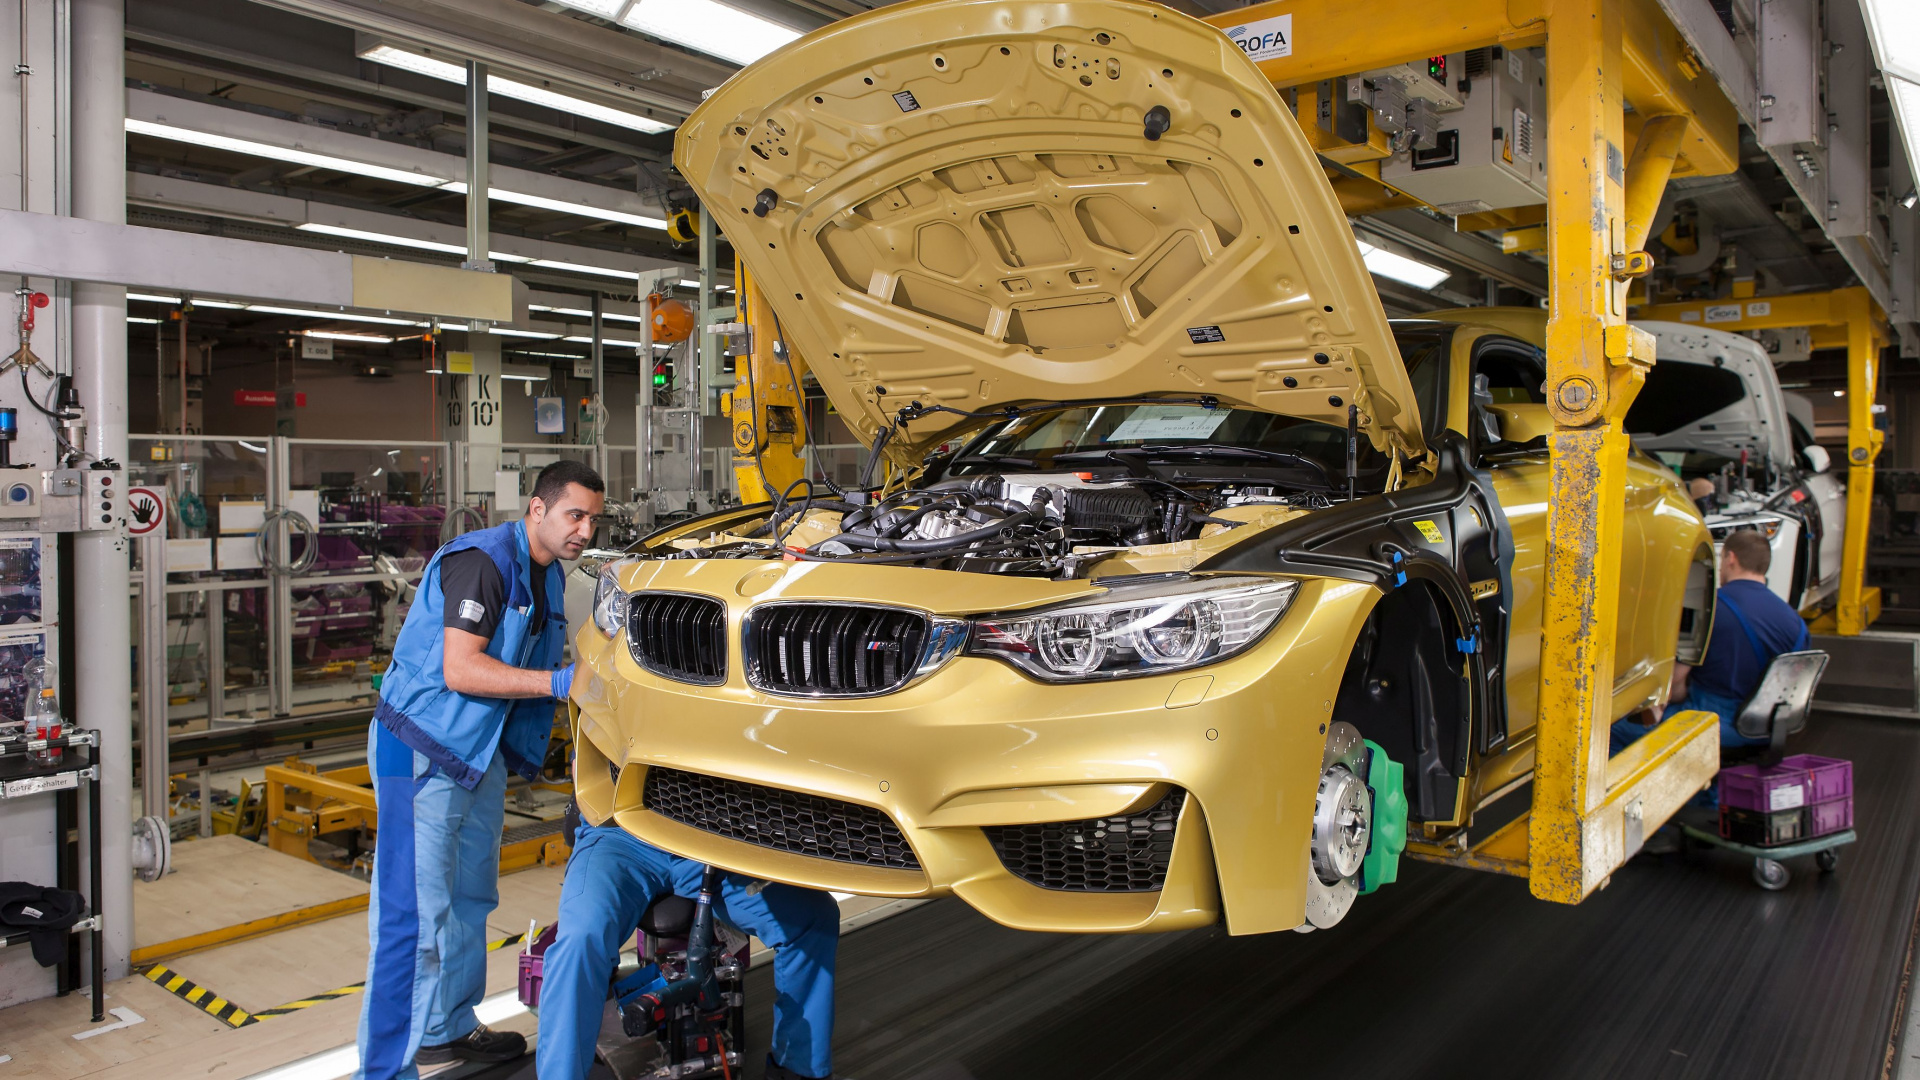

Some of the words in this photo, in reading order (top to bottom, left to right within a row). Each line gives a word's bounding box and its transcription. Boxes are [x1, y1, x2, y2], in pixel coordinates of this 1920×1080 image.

[1236, 32, 1286, 53] ROFA
[478, 374, 491, 399] K
[9, 779, 67, 793] Getrehalter
